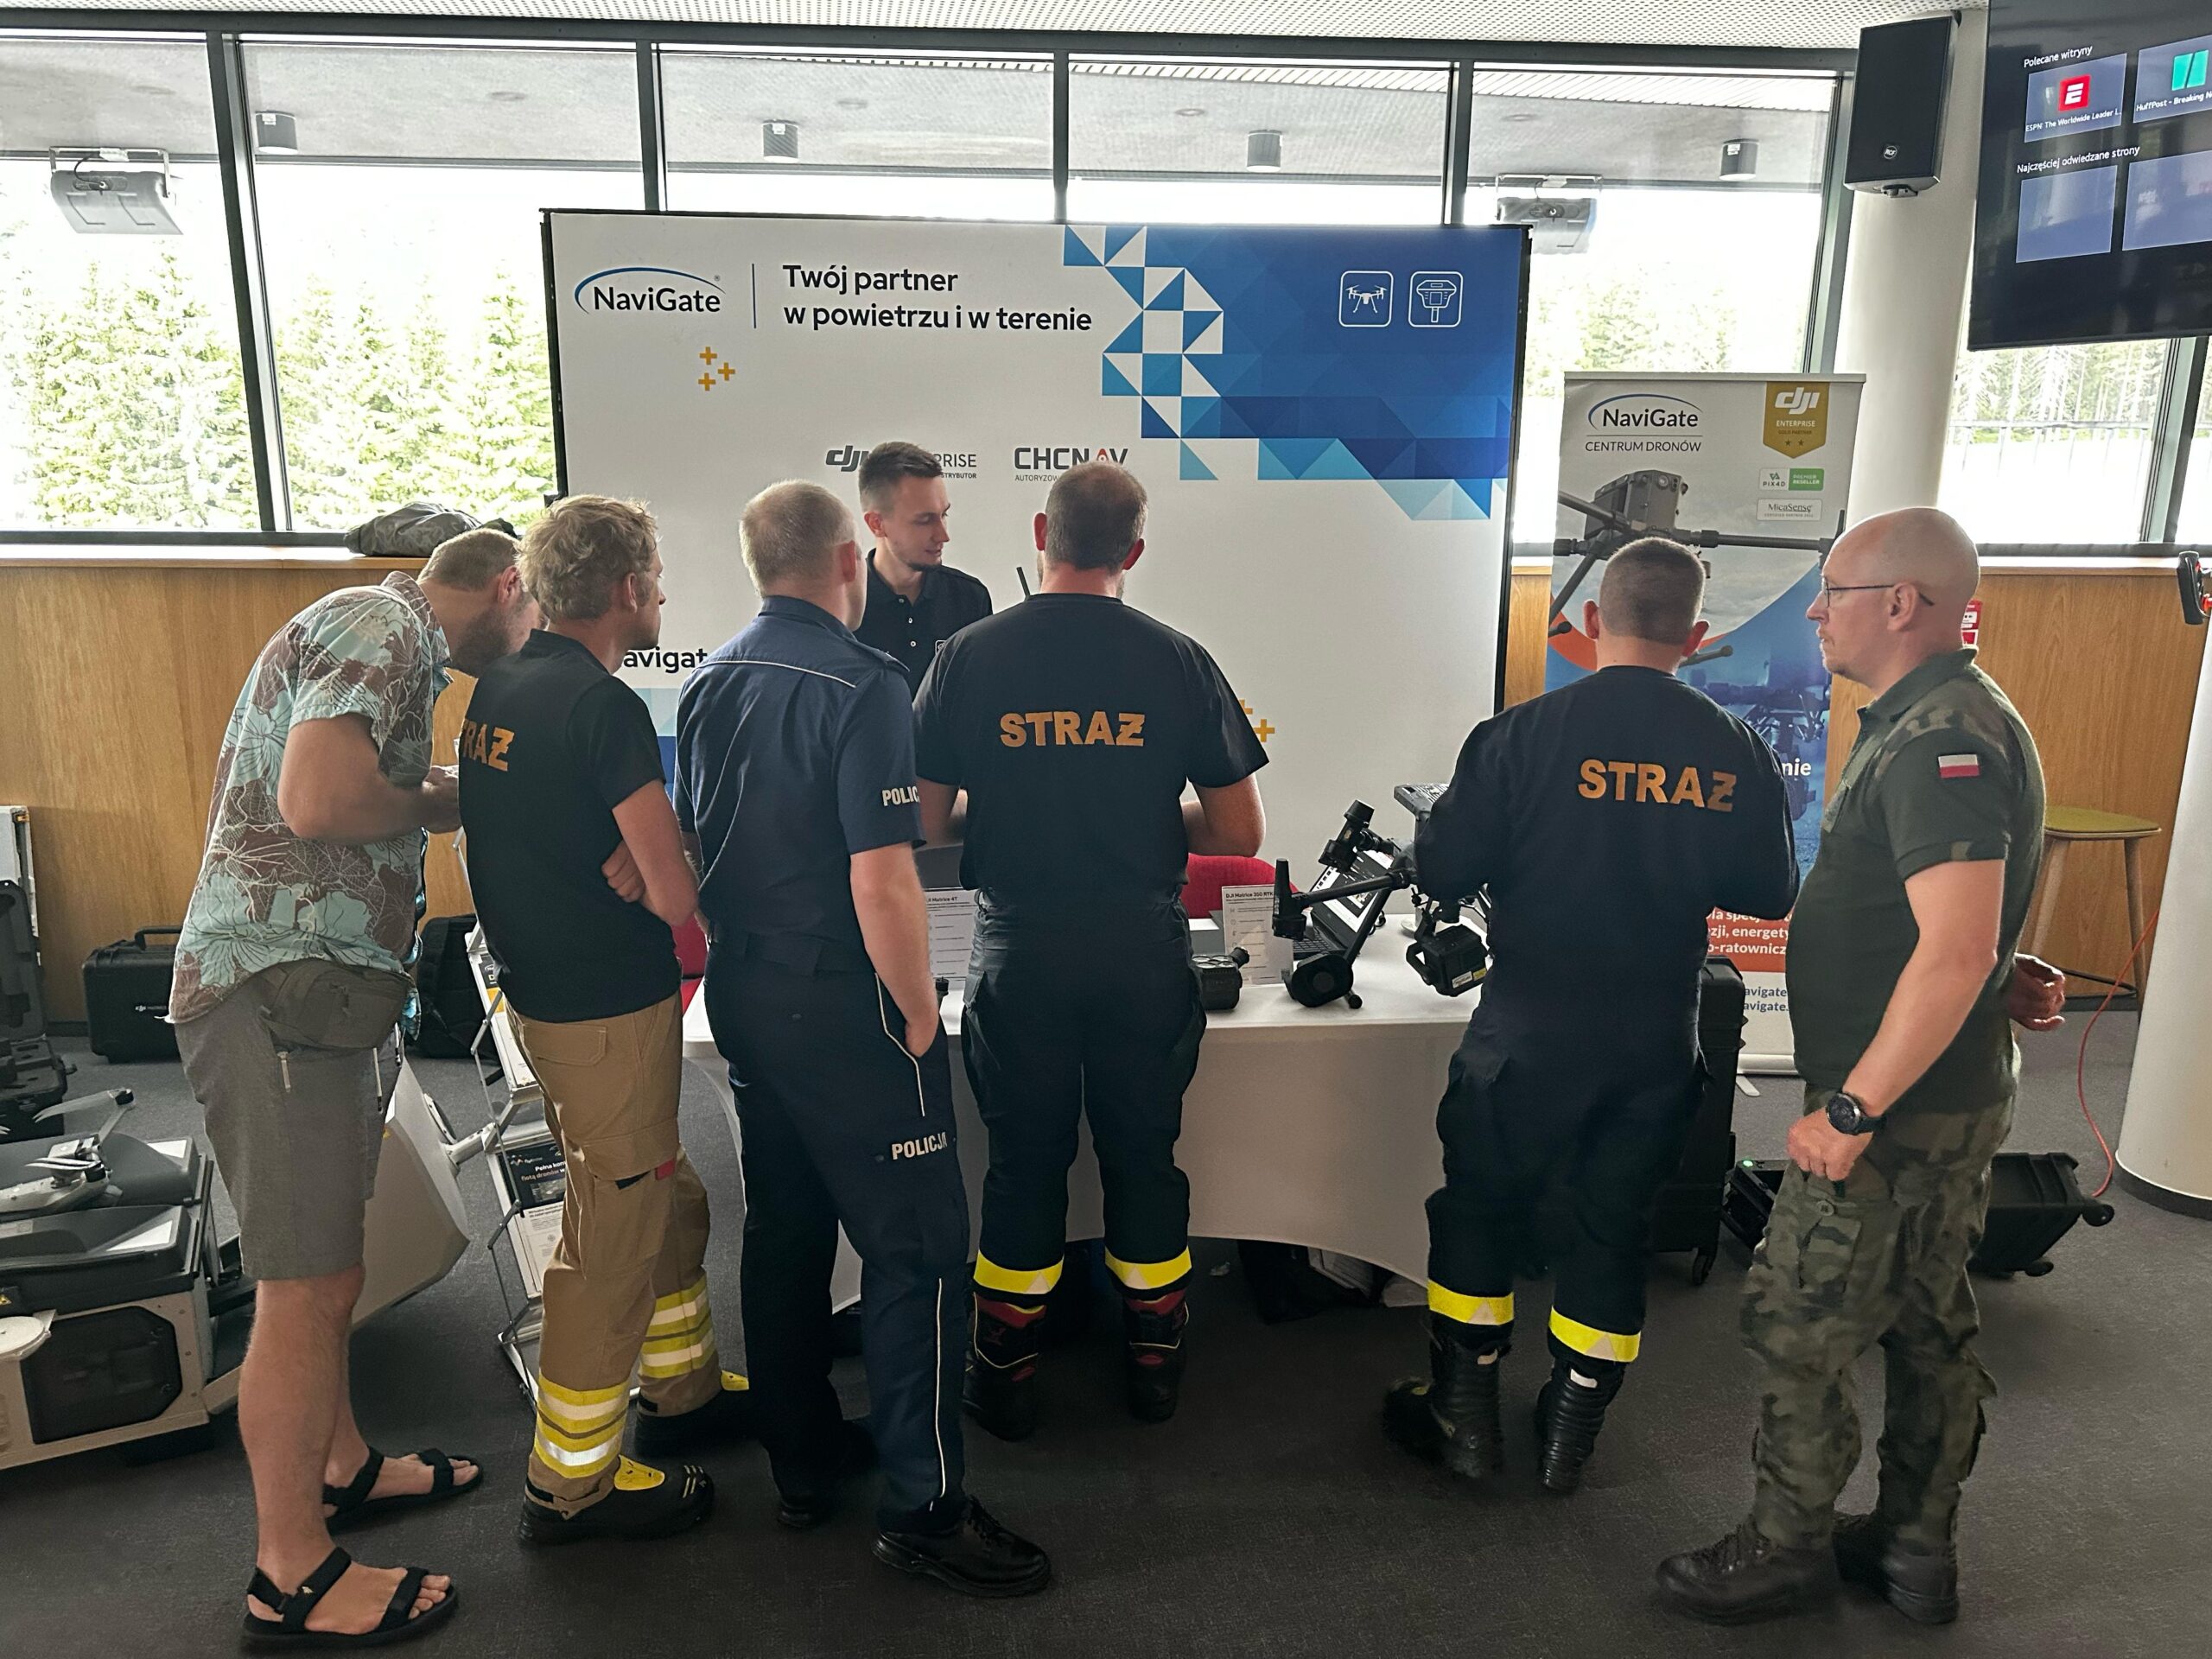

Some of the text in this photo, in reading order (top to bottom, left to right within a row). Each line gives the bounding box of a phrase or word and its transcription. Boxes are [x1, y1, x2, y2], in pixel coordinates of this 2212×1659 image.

[2024, 46, 2093, 67] Polecane witryny
[2136, 99, 2168, 111] HuffPost
[2173, 92, 2204, 105] Breaking
[2044, 120, 2056, 129] The
[2057, 113, 2090, 125] Worldwide
[2091, 110, 2113, 119] Leader
[2062, 150, 2110, 166] odwiedzane
[2111, 146, 2140, 158] strony
[782, 264, 958, 296] Twój partner
[594, 286, 721, 312] NaviGate
[784, 302, 1092, 331] w powietrzu i w terenie
[1603, 409, 1699, 428] NaviGate
[1585, 439, 1702, 452] CENTRUM DRONÓW
[933, 454, 976, 467] PRISE
[623, 645, 708, 674] avigat
[1782, 757, 1812, 776] nie
[881, 785, 920, 807] POLIC
[1710, 925, 1789, 941] zji, energety
[1708, 943, 1787, 955] o-ratownicz
[1745, 986, 1787, 998] avigate
[1744, 1001, 1789, 1013] avigate.
[891, 1131, 948, 1160] POLICJA
